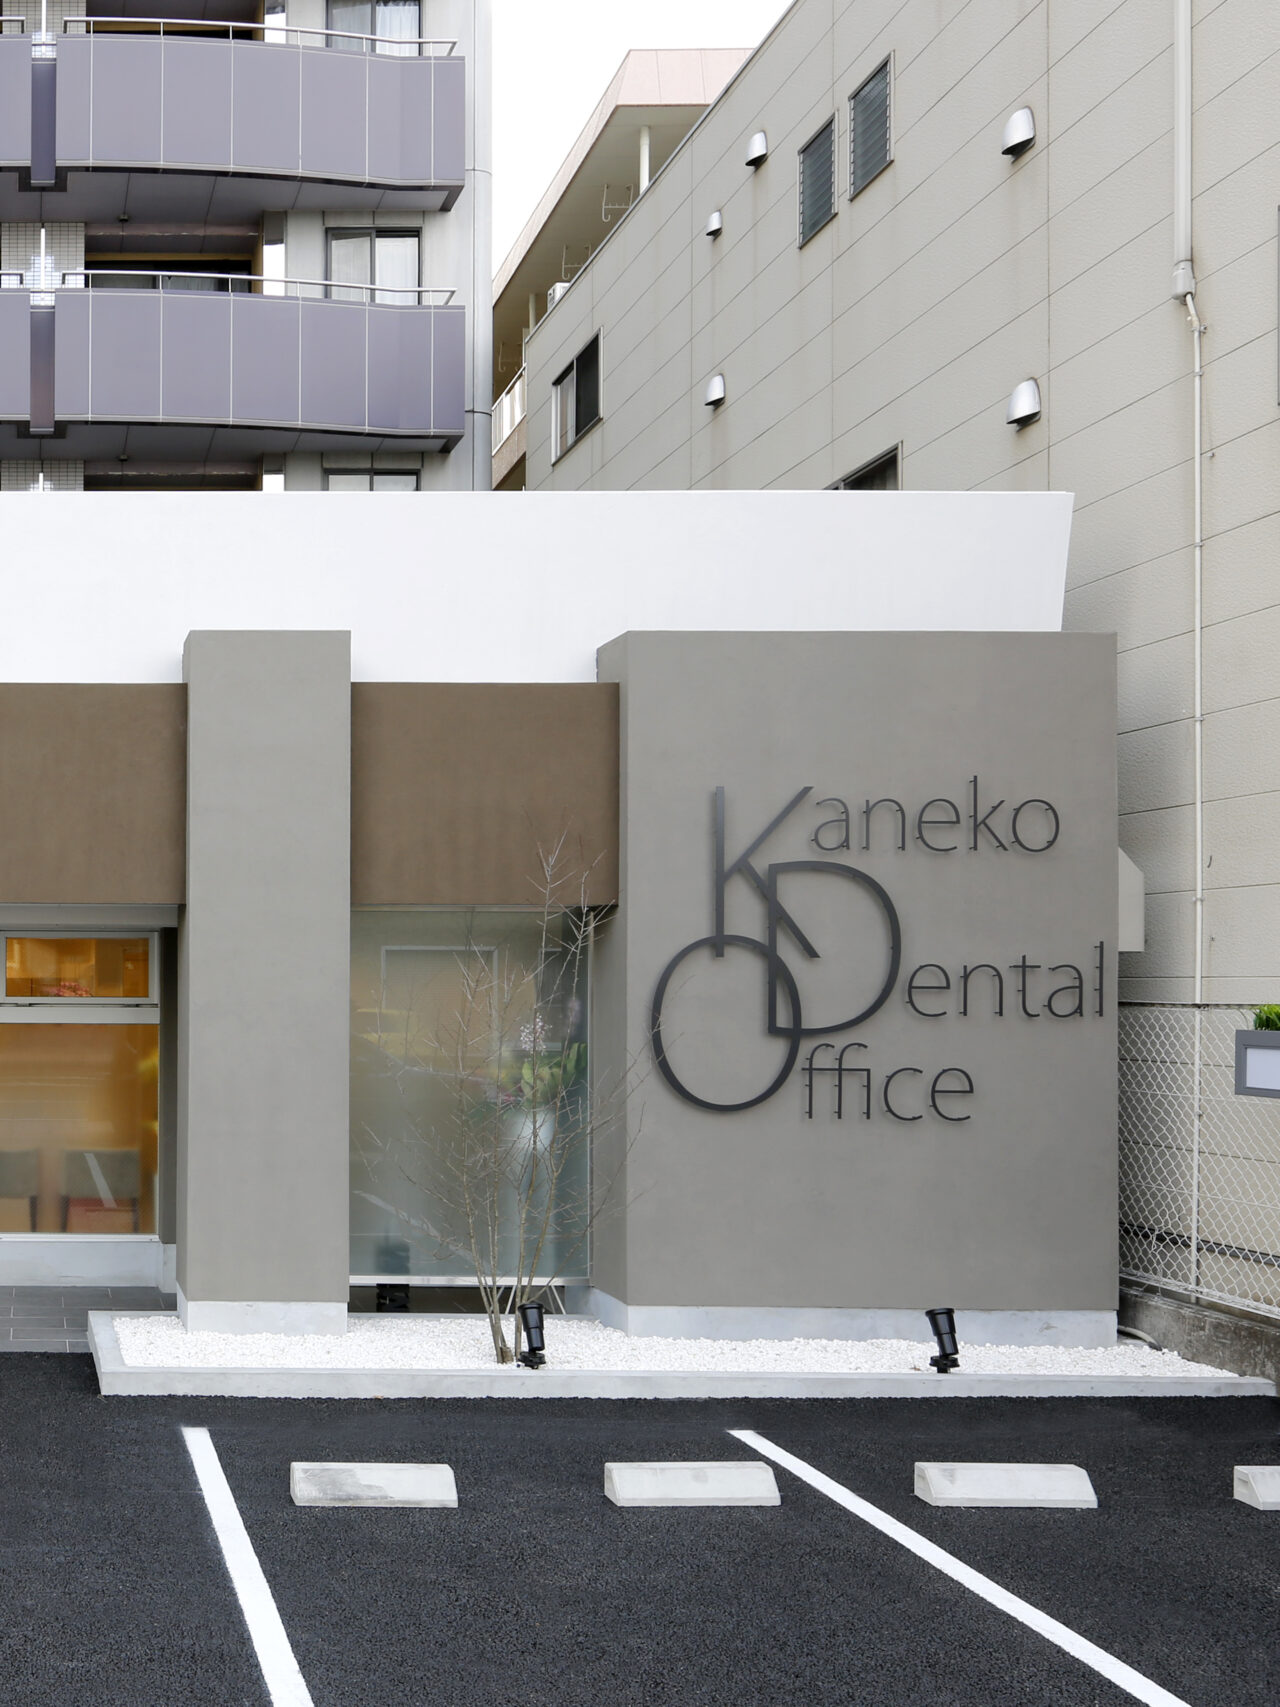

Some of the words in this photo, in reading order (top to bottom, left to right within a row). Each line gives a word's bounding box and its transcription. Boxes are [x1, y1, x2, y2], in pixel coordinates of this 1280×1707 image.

[713, 775, 1061, 958] Kaneko
[767, 860, 1105, 1034] Dental
[652, 934, 974, 1121] Office
